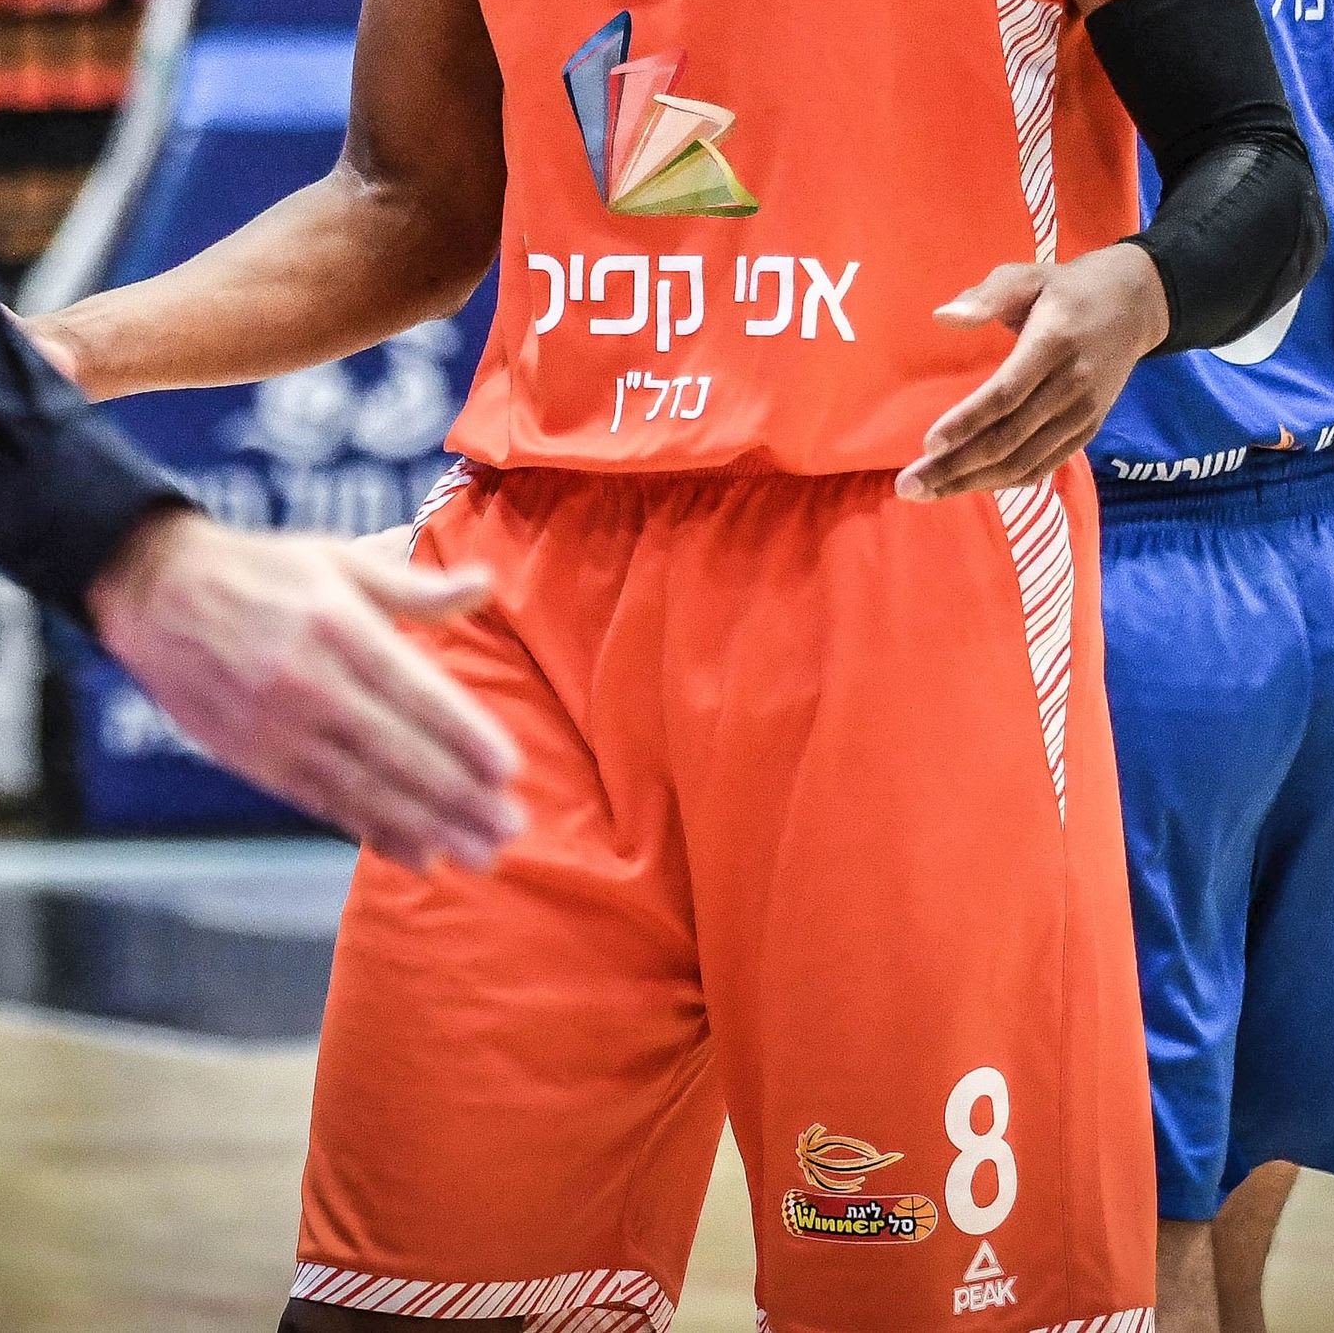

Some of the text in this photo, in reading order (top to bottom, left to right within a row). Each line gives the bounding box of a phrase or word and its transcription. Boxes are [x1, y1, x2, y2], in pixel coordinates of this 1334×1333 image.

[734, 254, 861, 342] אפי
[944, 1066, 1018, 1235] 8
[795, 1203, 886, 1235] Winner
[847, 1202, 882, 1219] ליגת
[888, 1214, 915, 1233] סל
[952, 1276, 1018, 1315] PEAK
